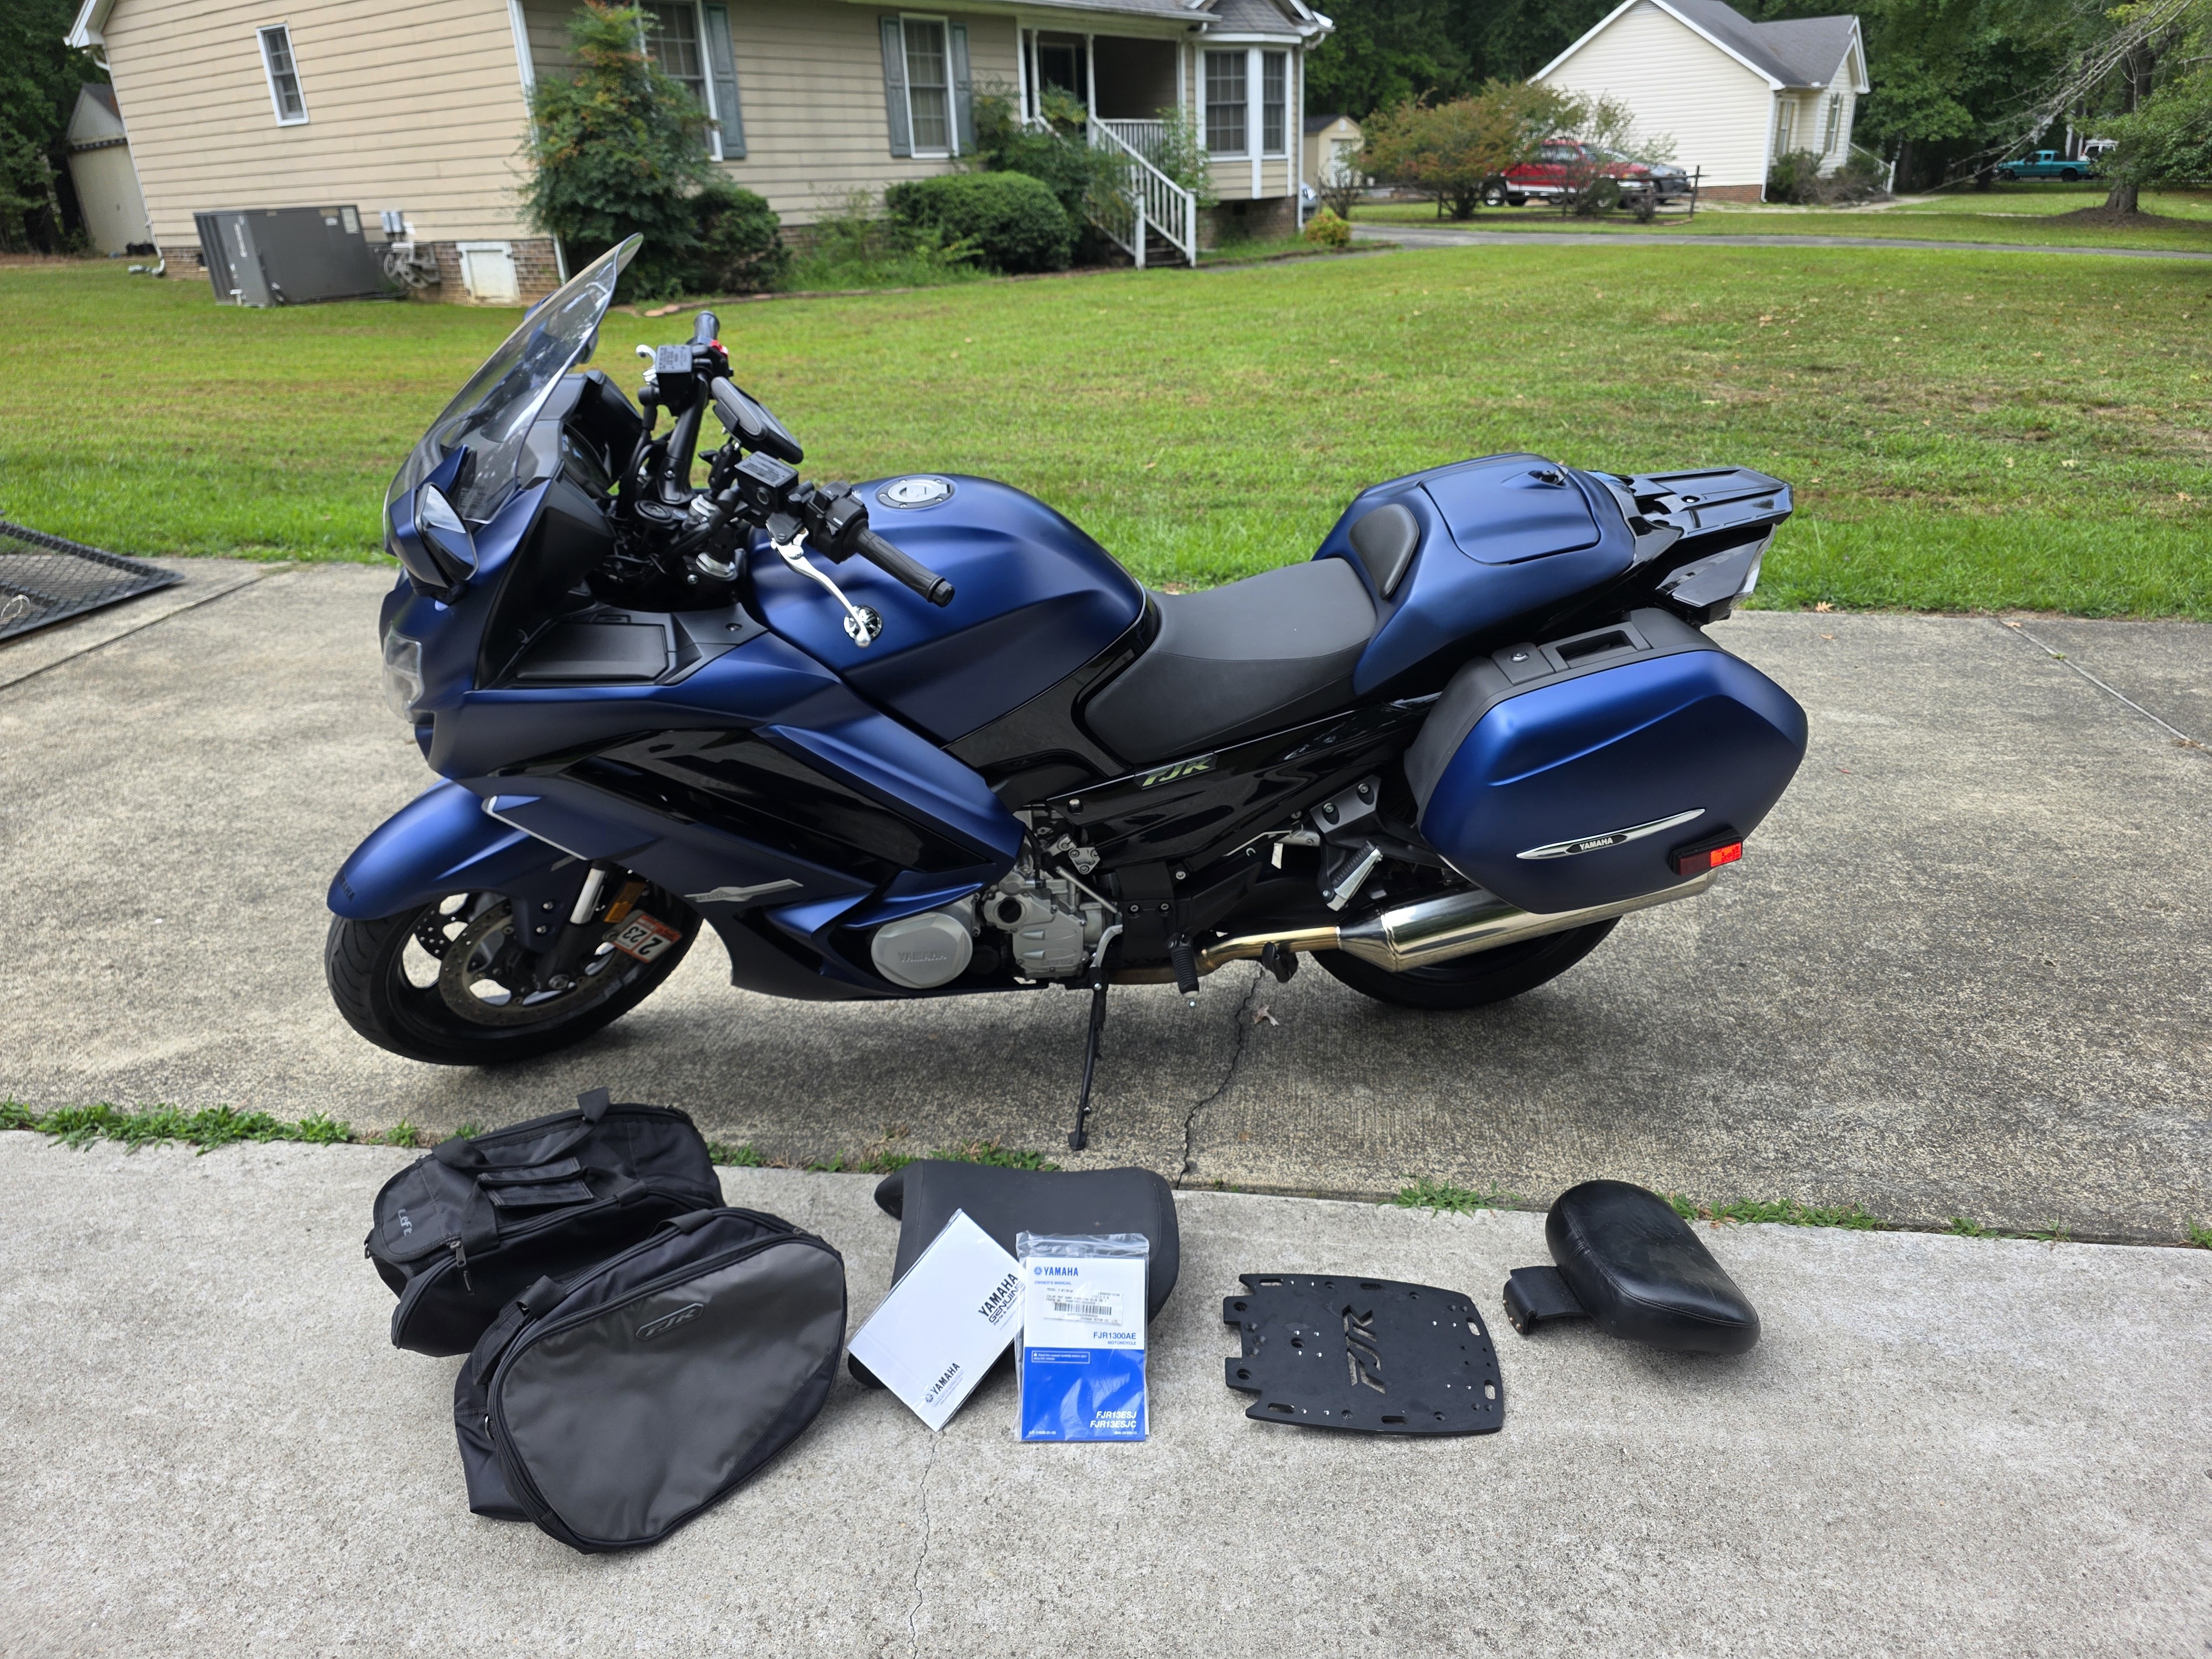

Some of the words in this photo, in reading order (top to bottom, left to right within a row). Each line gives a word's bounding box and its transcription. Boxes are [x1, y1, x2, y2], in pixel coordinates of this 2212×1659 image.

[1142, 755, 1212, 786] FJR
[1579, 837, 1613, 851] YAMAHA
[622, 926, 647, 943] 23
[638, 937, 663, 956] 2
[898, 950, 947, 963] YAMAHA
[1044, 1266, 1078, 1276] YAMAHA
[978, 1273, 1018, 1317] YAMAHA
[989, 1280, 1026, 1323] GENUINE
[644, 1308, 697, 1337] FJR
[1093, 1332, 1136, 1340] FJR1300AE
[1342, 1304, 1385, 1395] FJR
[930, 1363, 960, 1395] YAMAHA
